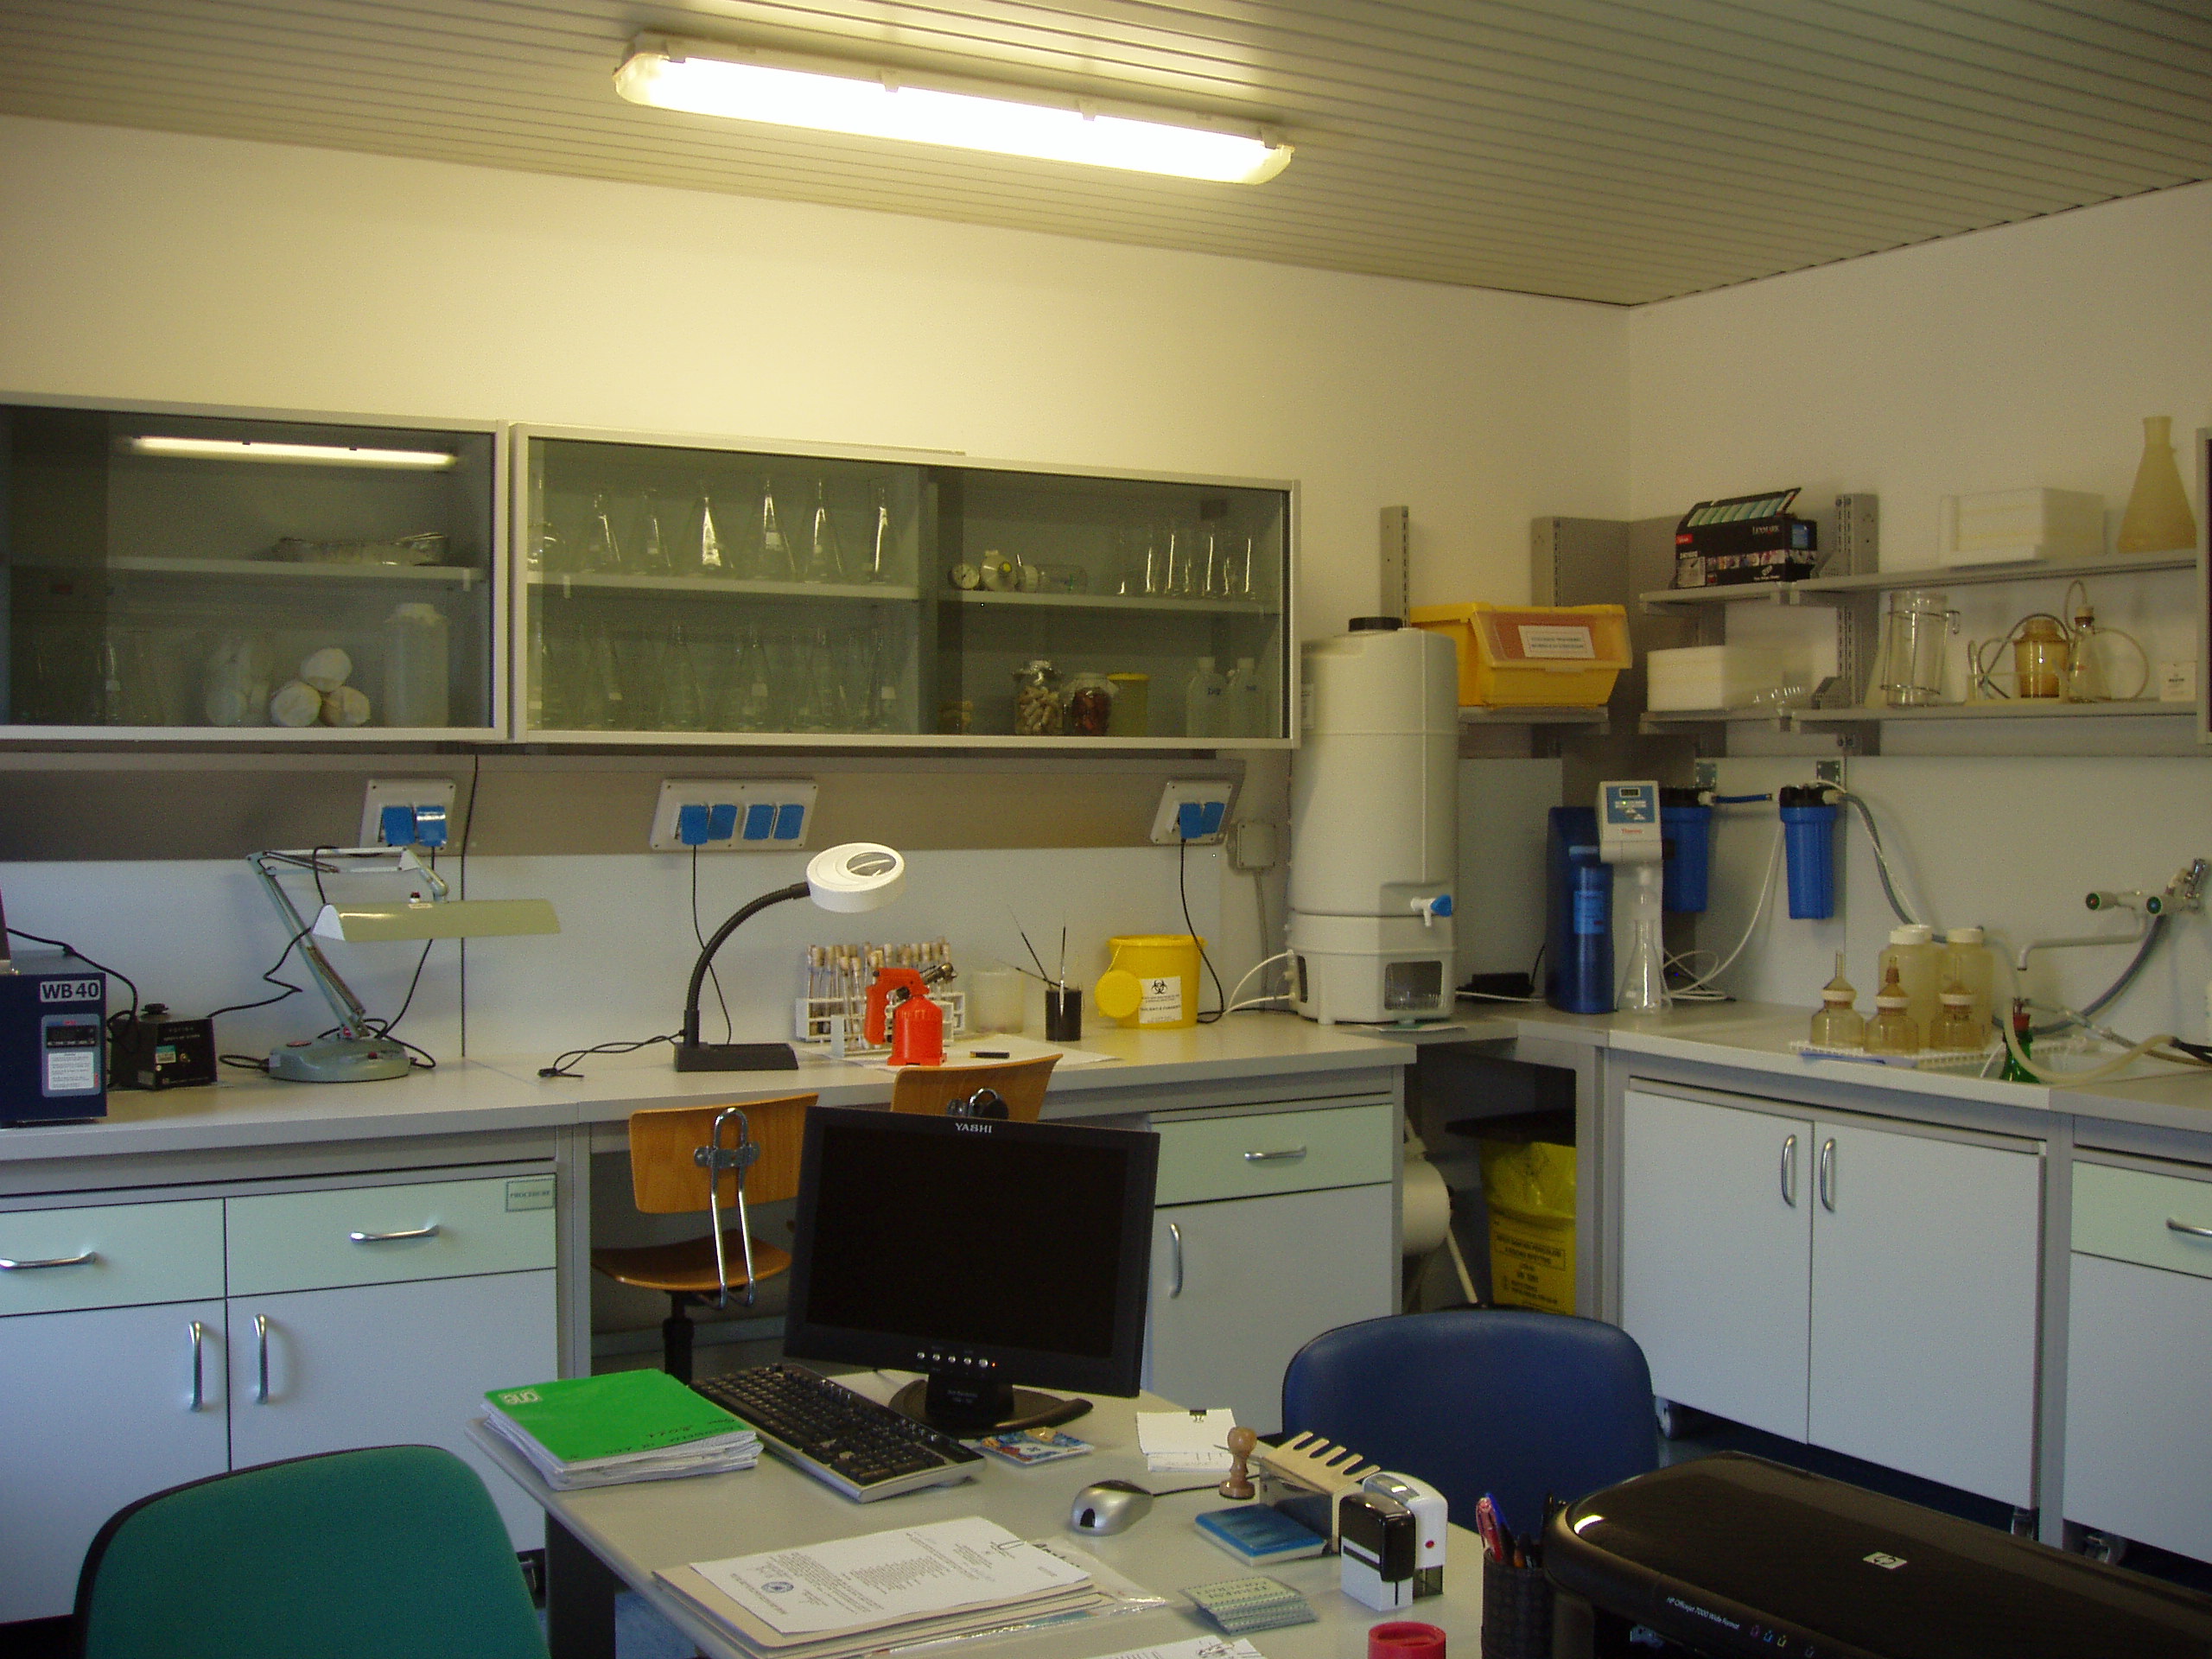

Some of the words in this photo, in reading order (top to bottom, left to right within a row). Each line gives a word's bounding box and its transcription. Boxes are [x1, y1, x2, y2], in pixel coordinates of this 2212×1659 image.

[42, 982, 73, 1000] WB
[75, 982, 99, 998] 40
[955, 1122, 993, 1134] YASHI
